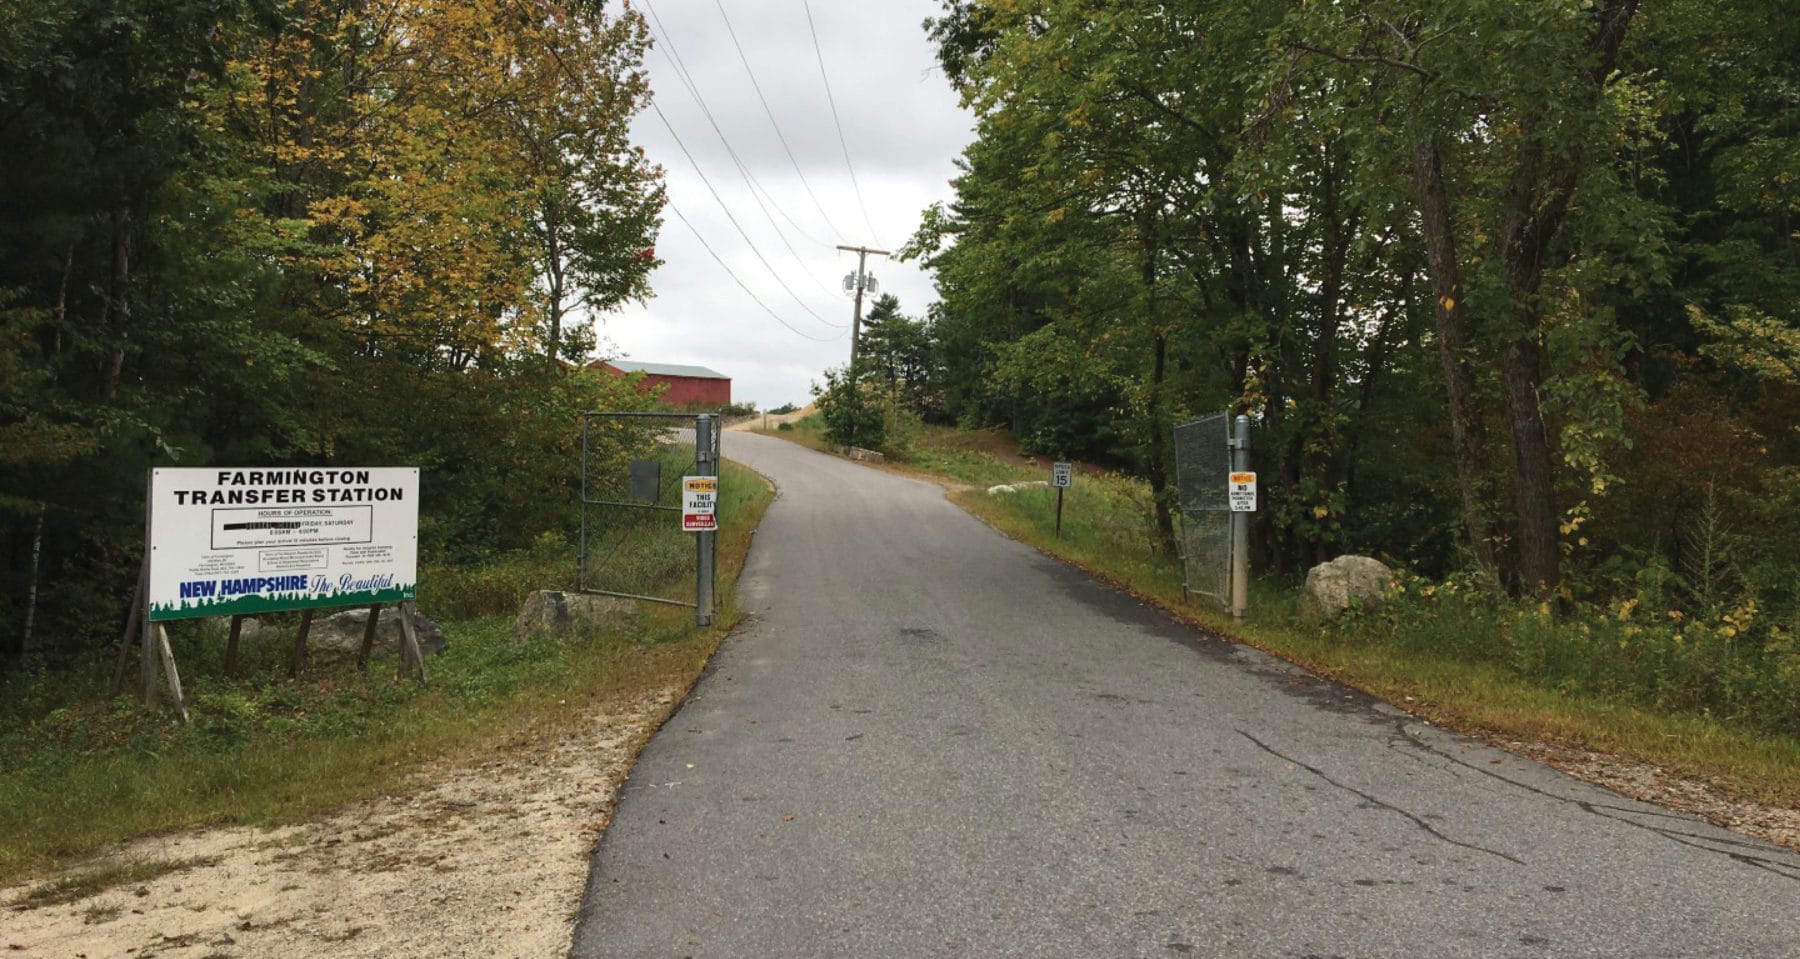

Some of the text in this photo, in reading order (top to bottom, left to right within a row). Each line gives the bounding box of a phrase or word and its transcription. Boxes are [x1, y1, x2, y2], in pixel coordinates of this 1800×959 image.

[217, 471, 369, 485] FARMINGTON
[1056, 475, 1067, 485] 15
[174, 488, 403, 505] TRANSFER STATION
[180, 573, 393, 598] NEW HAMPSHIRE The Beautiful
